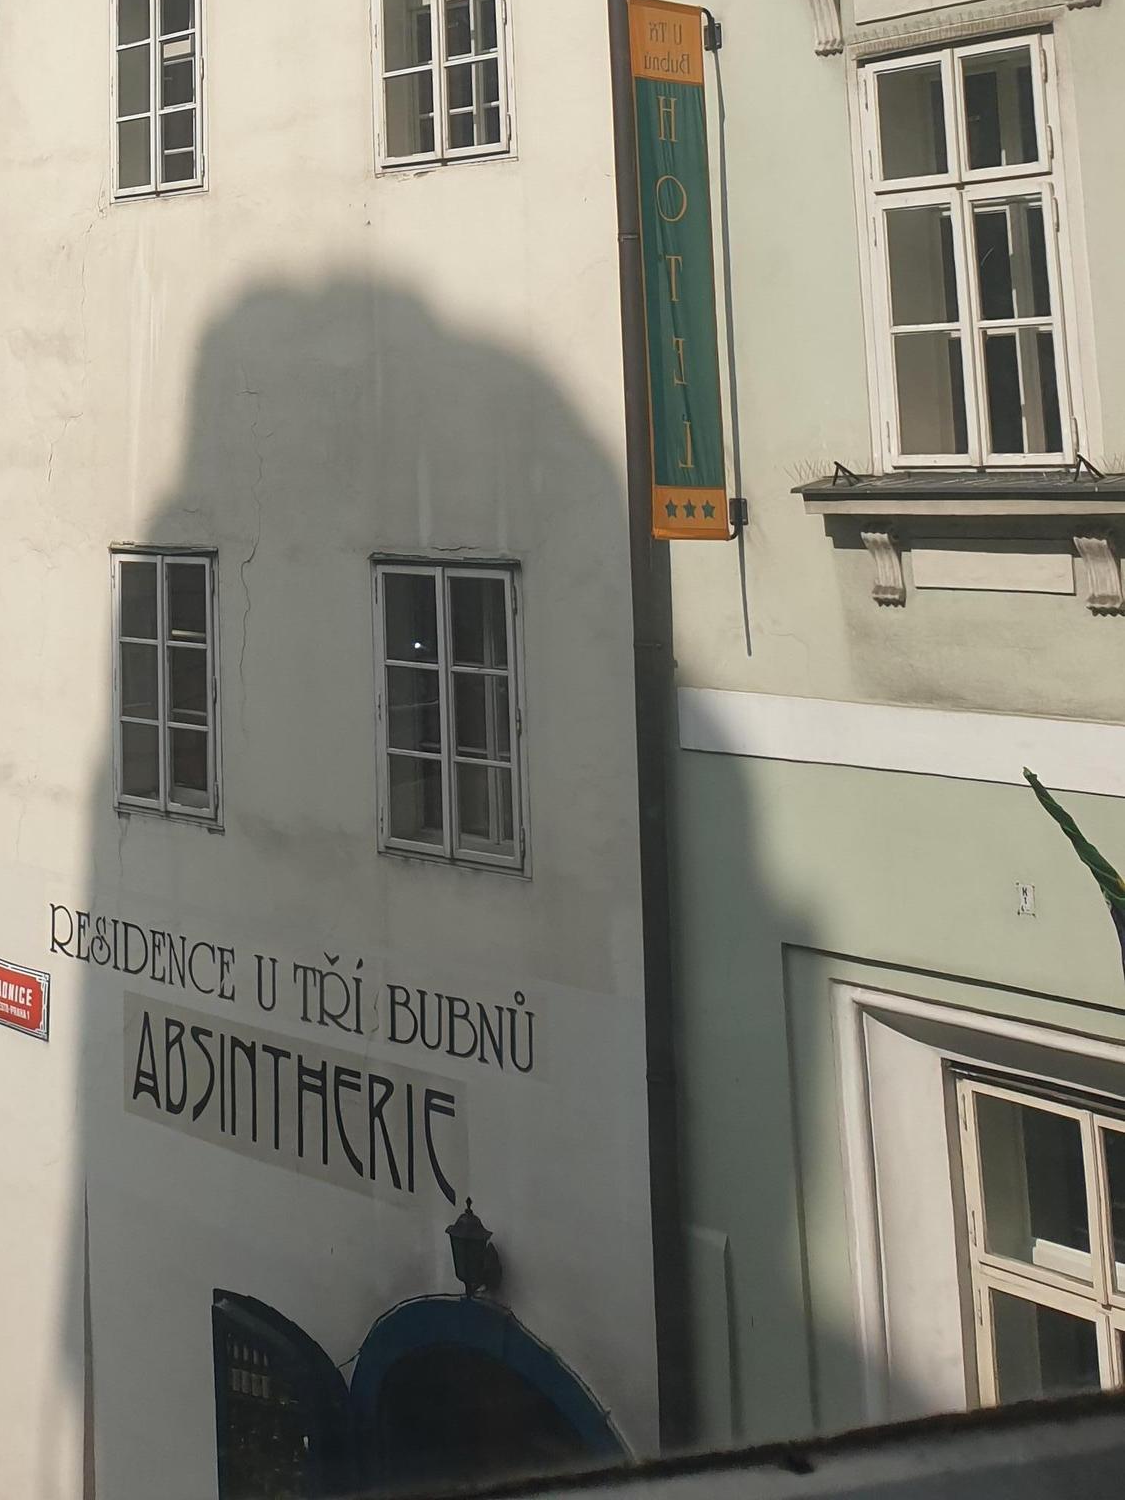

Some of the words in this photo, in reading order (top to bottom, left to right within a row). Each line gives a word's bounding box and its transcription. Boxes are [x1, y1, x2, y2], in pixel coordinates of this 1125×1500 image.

[49, 903, 236, 1002] RESIDENCE
[253, 954, 278, 1012] U
[293, 951, 364, 1035] TŘÍ
[386, 984, 535, 1074] BUBNŮ
[132, 1011, 456, 1206] ABSINTHERIE
